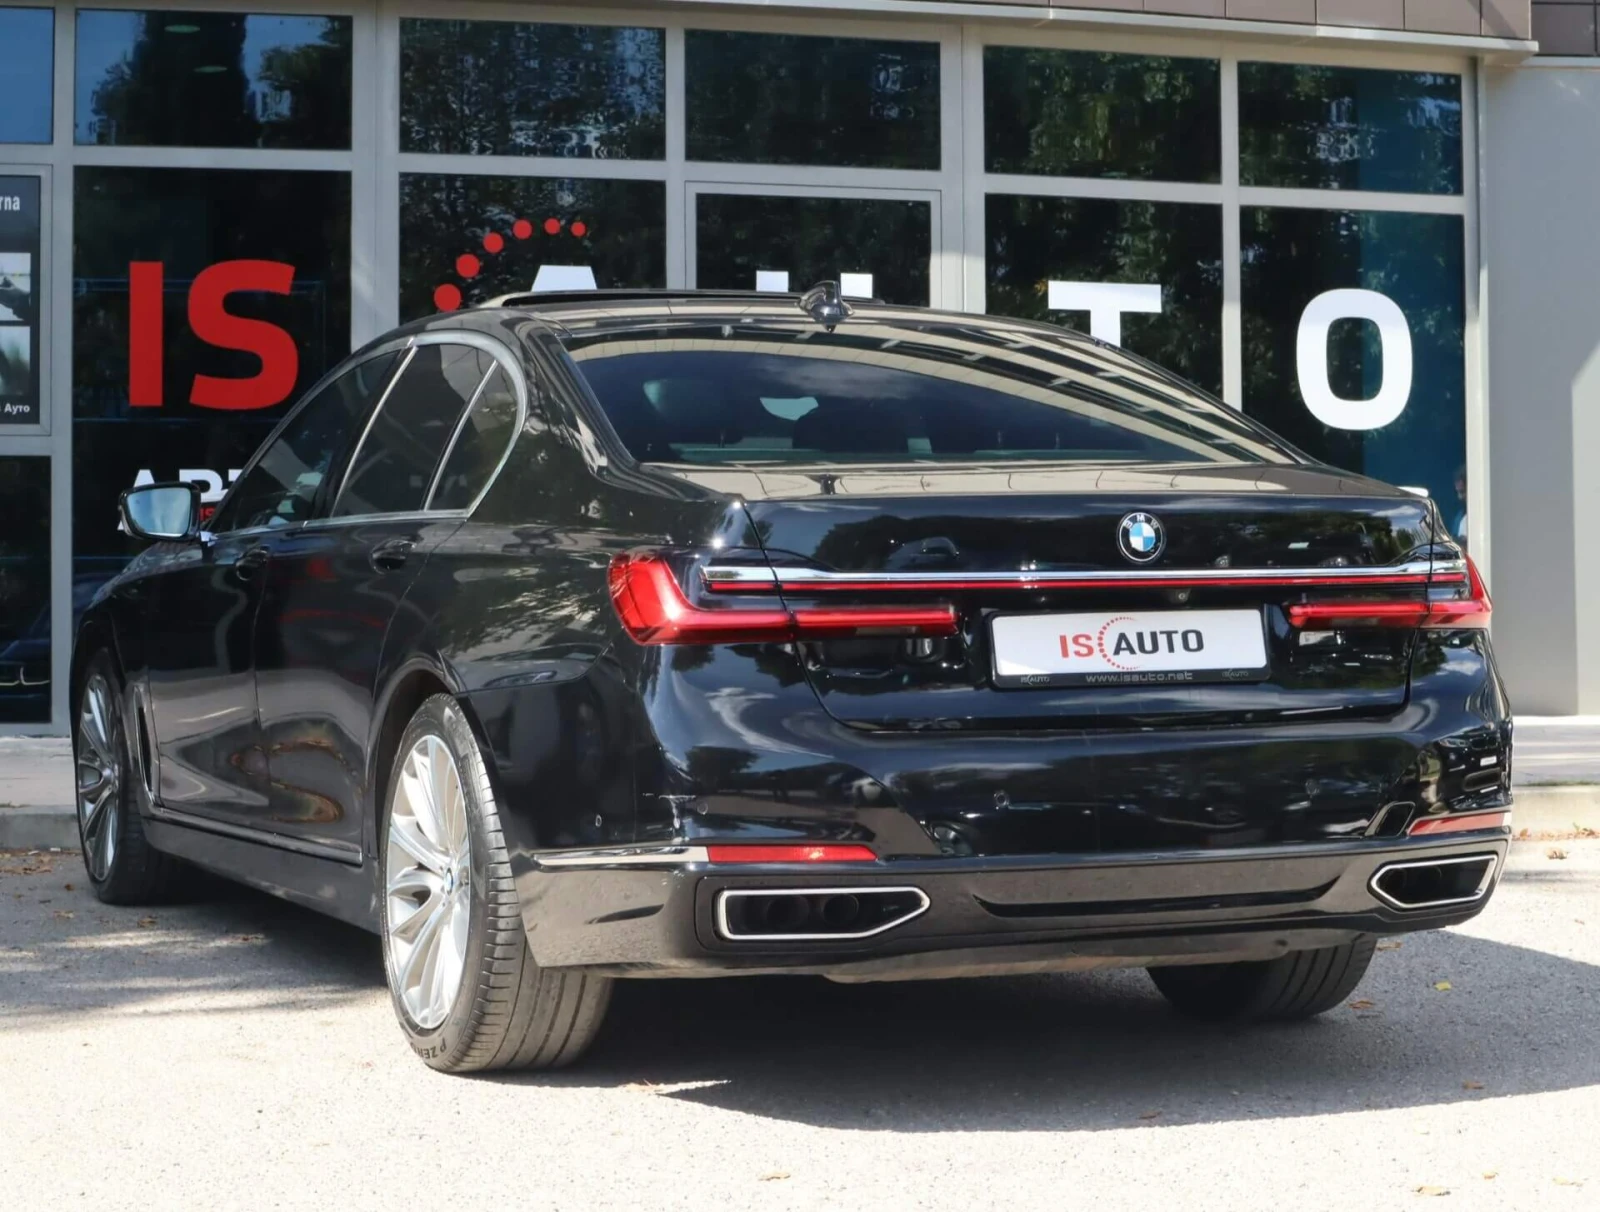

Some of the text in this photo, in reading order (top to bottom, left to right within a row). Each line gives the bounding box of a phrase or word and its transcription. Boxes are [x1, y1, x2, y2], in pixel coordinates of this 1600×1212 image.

[129, 259, 1413, 431] IS TO
[1059, 629, 1205, 658] IS AUTO
[1085, 671, 1194, 683] www.isauto.net
